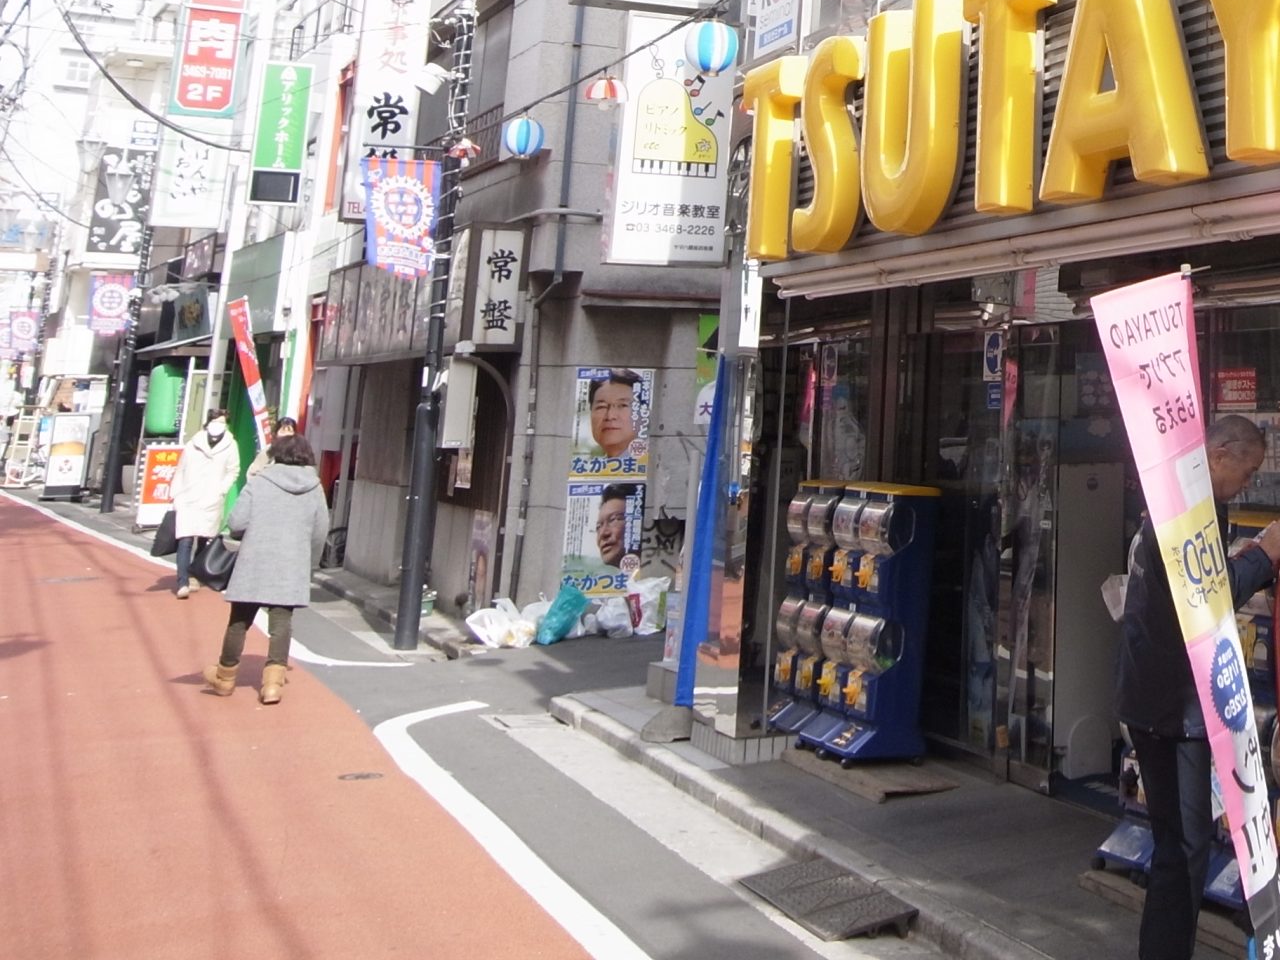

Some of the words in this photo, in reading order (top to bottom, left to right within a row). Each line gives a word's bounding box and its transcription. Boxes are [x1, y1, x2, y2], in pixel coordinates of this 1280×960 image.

[186, 83, 224, 102] 2F
[620, 200, 721, 219] ジリオ音楽教室
[480, 248, 518, 332] 常盤
[572, 457, 637, 474] ながつま
